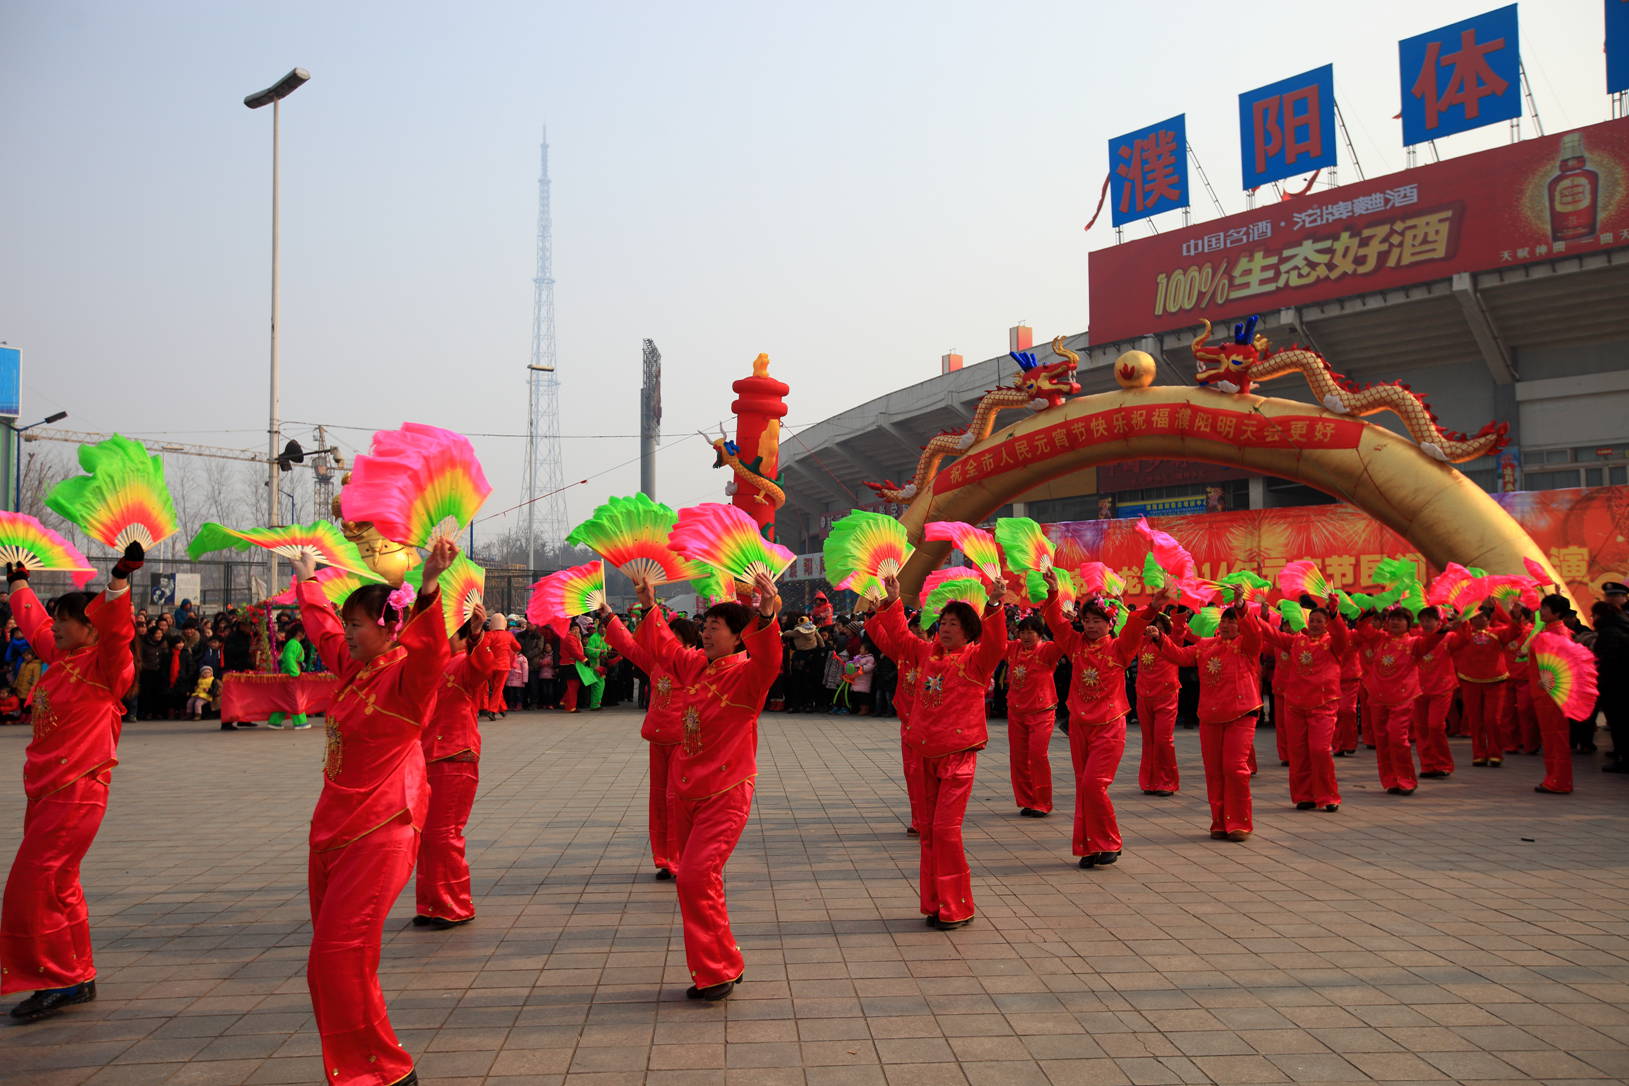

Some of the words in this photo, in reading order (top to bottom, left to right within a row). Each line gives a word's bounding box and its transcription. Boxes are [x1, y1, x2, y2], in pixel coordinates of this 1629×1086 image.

[1154, 210, 1453, 315] 100%生态好酒
[950, 407, 1336, 484] 祝全市人民元宵节快乐祝福濮阳明天会更好
